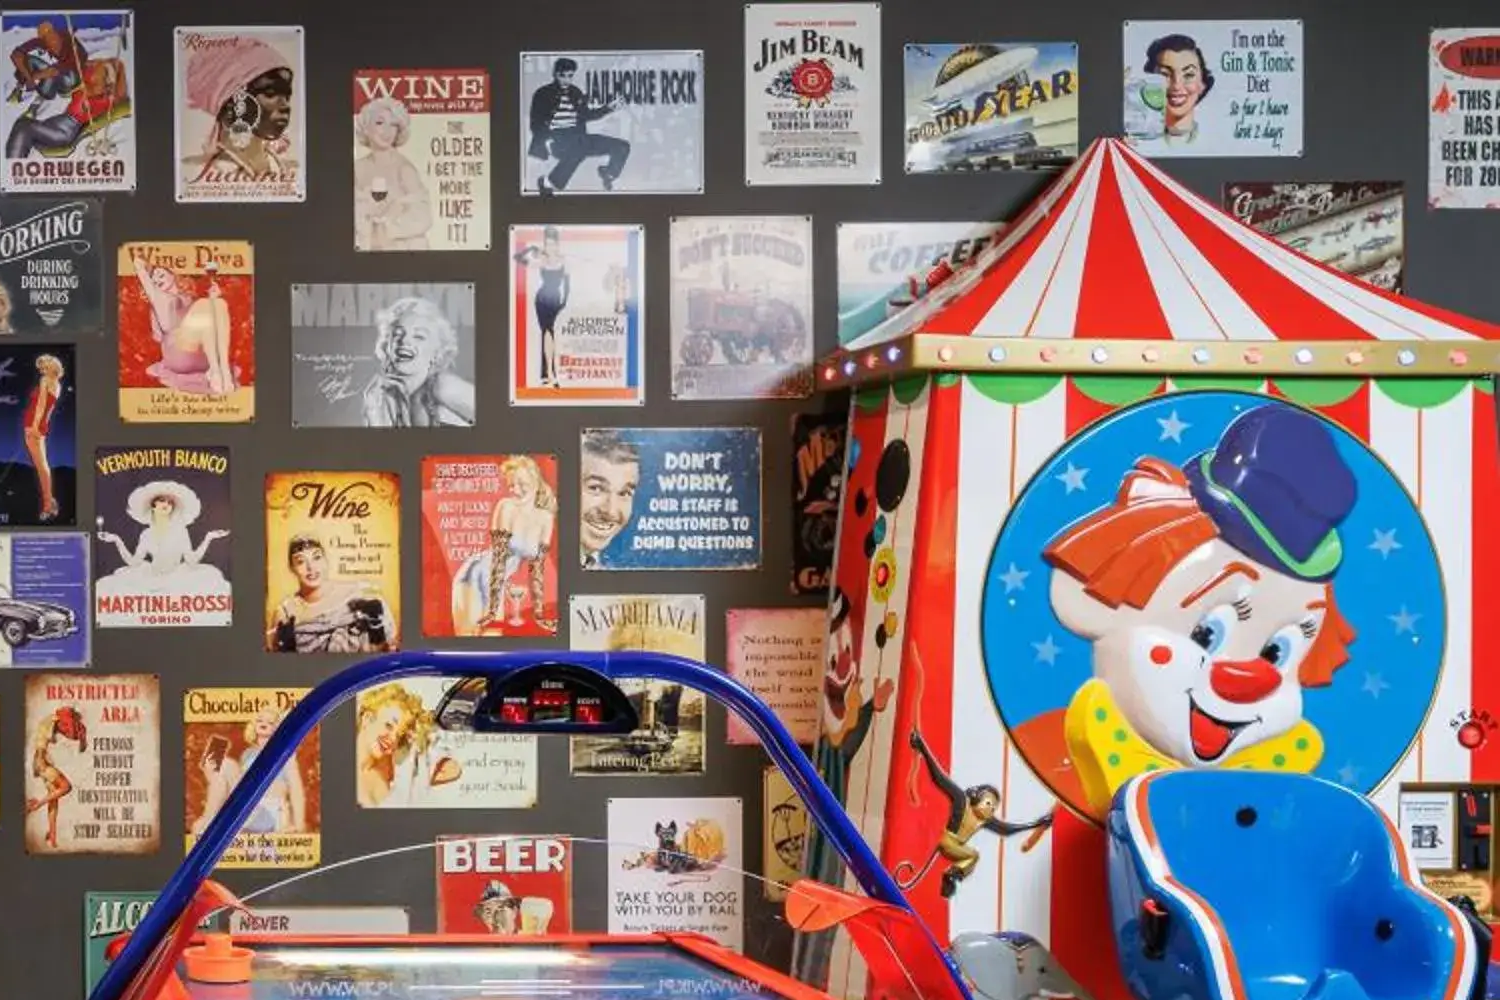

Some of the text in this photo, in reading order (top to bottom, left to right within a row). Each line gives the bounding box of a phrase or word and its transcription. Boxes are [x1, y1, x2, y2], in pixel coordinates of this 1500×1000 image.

[1232, 29, 1285, 48] I'm on the
[753, 29, 864, 73] JIM BEAM
[1221, 51, 1295, 72] Gin & Tonic
[356, 75, 485, 99] WINE
[586, 70, 696, 104] JAILHOUSE ROCK
[1247, 74, 1270, 93] Diet
[1458, 90, 1491, 110] THIS
[767, 110, 853, 120] KENTUCKY STRAIGHT
[1240, 98, 1289, 124] far have
[772, 121, 811, 130] BOURBON
[1464, 116, 1493, 135] HAS
[430, 137, 483, 156] OLDER
[1442, 141, 1477, 160] BEEN
[12, 160, 125, 177] NORWEGEN
[435, 162, 483, 176] GET THE
[1445, 166, 1473, 186] FOR
[439, 181, 471, 195] MORE
[446, 200, 473, 218] LIKE
[128, 245, 244, 269] Wine Diva
[27, 259, 73, 274] DURING
[21, 275, 79, 289] DRINKING
[30, 289, 69, 304] HOURS
[567, 317, 619, 327] AUDREY
[561, 326, 625, 335] HEPBURN
[97, 449, 227, 475] VERMOUTH BIANCO
[665, 451, 724, 470] DON'T
[657, 474, 733, 494] WORRY,
[291, 482, 375, 519] Wine
[649, 498, 739, 511] OUR STAFF IS
[352, 523, 368, 534] The
[637, 516, 749, 531] ACCUSTOMED TO
[633, 535, 754, 551] DUMB QUESTIONS
[140, 615, 191, 624] TORINO
[576, 601, 698, 637] MAURETANIA
[744, 635, 803, 647] Nothing
[745, 667, 769, 677] the
[46, 683, 139, 700] RESTRICTED
[101, 706, 142, 722] AREA
[1450, 708, 1498, 733] START
[93, 737, 134, 750] PERSONS
[93, 754, 134, 768] WITHOUT
[95, 772, 132, 786] PROPER
[93, 807, 116, 820] WILL
[73, 824, 152, 839] STRIP SEARCHED
[443, 839, 565, 873] BEER
[616, 891, 737, 904] TAKE YOUR DOG
[615, 905, 738, 916] WITH YOU BY RAIL
[239, 915, 289, 931] NEVER
